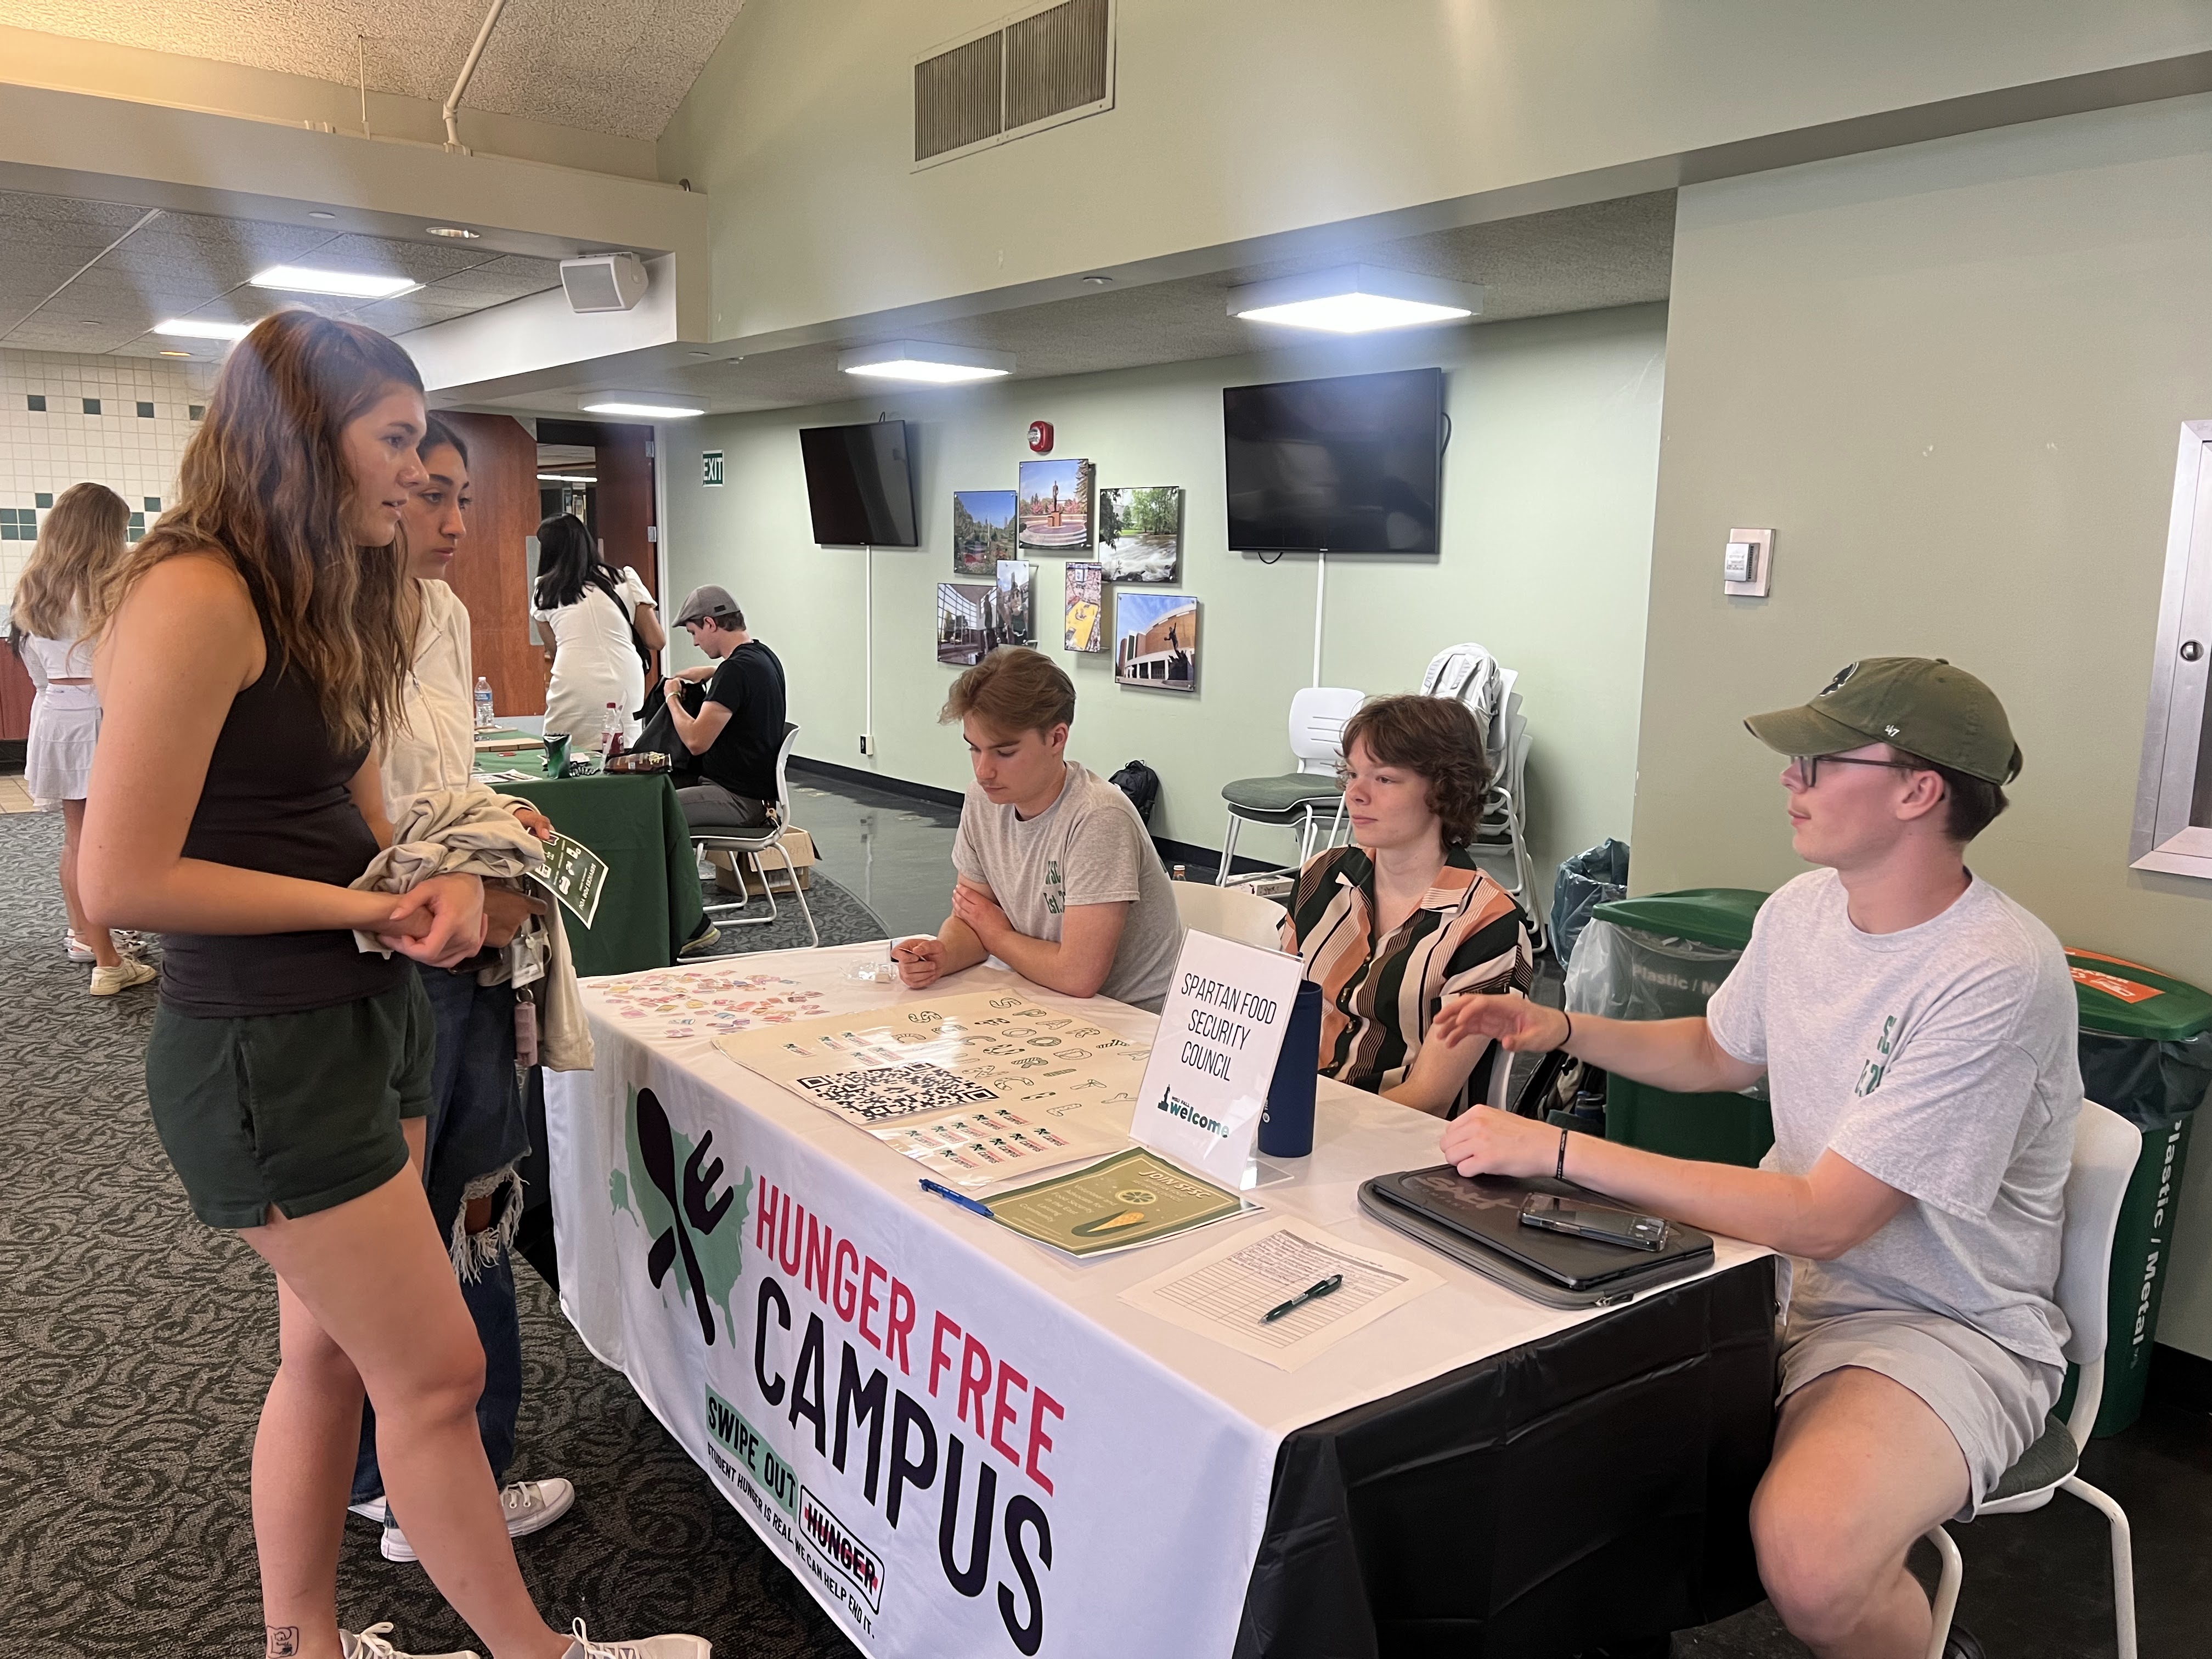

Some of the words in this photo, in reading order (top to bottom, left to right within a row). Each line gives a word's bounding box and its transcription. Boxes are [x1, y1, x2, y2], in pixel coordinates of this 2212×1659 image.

[703, 457, 723, 481] EXIT
[1181, 973, 1242, 1013] SPARTAN
[1240, 992, 1277, 1025] FOOD
[1632, 963, 1689, 990] Plastic
[1188, 1009, 1251, 1051] SECURITY
[1181, 1041, 1232, 1082] COUNCIL
[1170, 1101, 1230, 1138] welcome
[1138, 1171, 1179, 1186] JOIN
[1174, 1183, 1211, 1199] SFSC
[2132, 1251, 2159, 1345] Metal
[756, 1175, 916, 1376] HUNGER
[928, 1310, 1064, 1498] FREE
[754, 1276, 1052, 1656] CAMPUS
[708, 1396, 759, 1472] SWIPE
[764, 1452, 796, 1509] OUT
[807, 1502, 876, 1595] HUNGER
[764, 1504, 771, 1522] IS
[795, 1537, 806, 1562] WE
[807, 1554, 823, 1582] CAN
[824, 1571, 847, 1602] HELP
[848, 1594, 862, 1624] END
[864, 1616, 875, 1639] IT.
